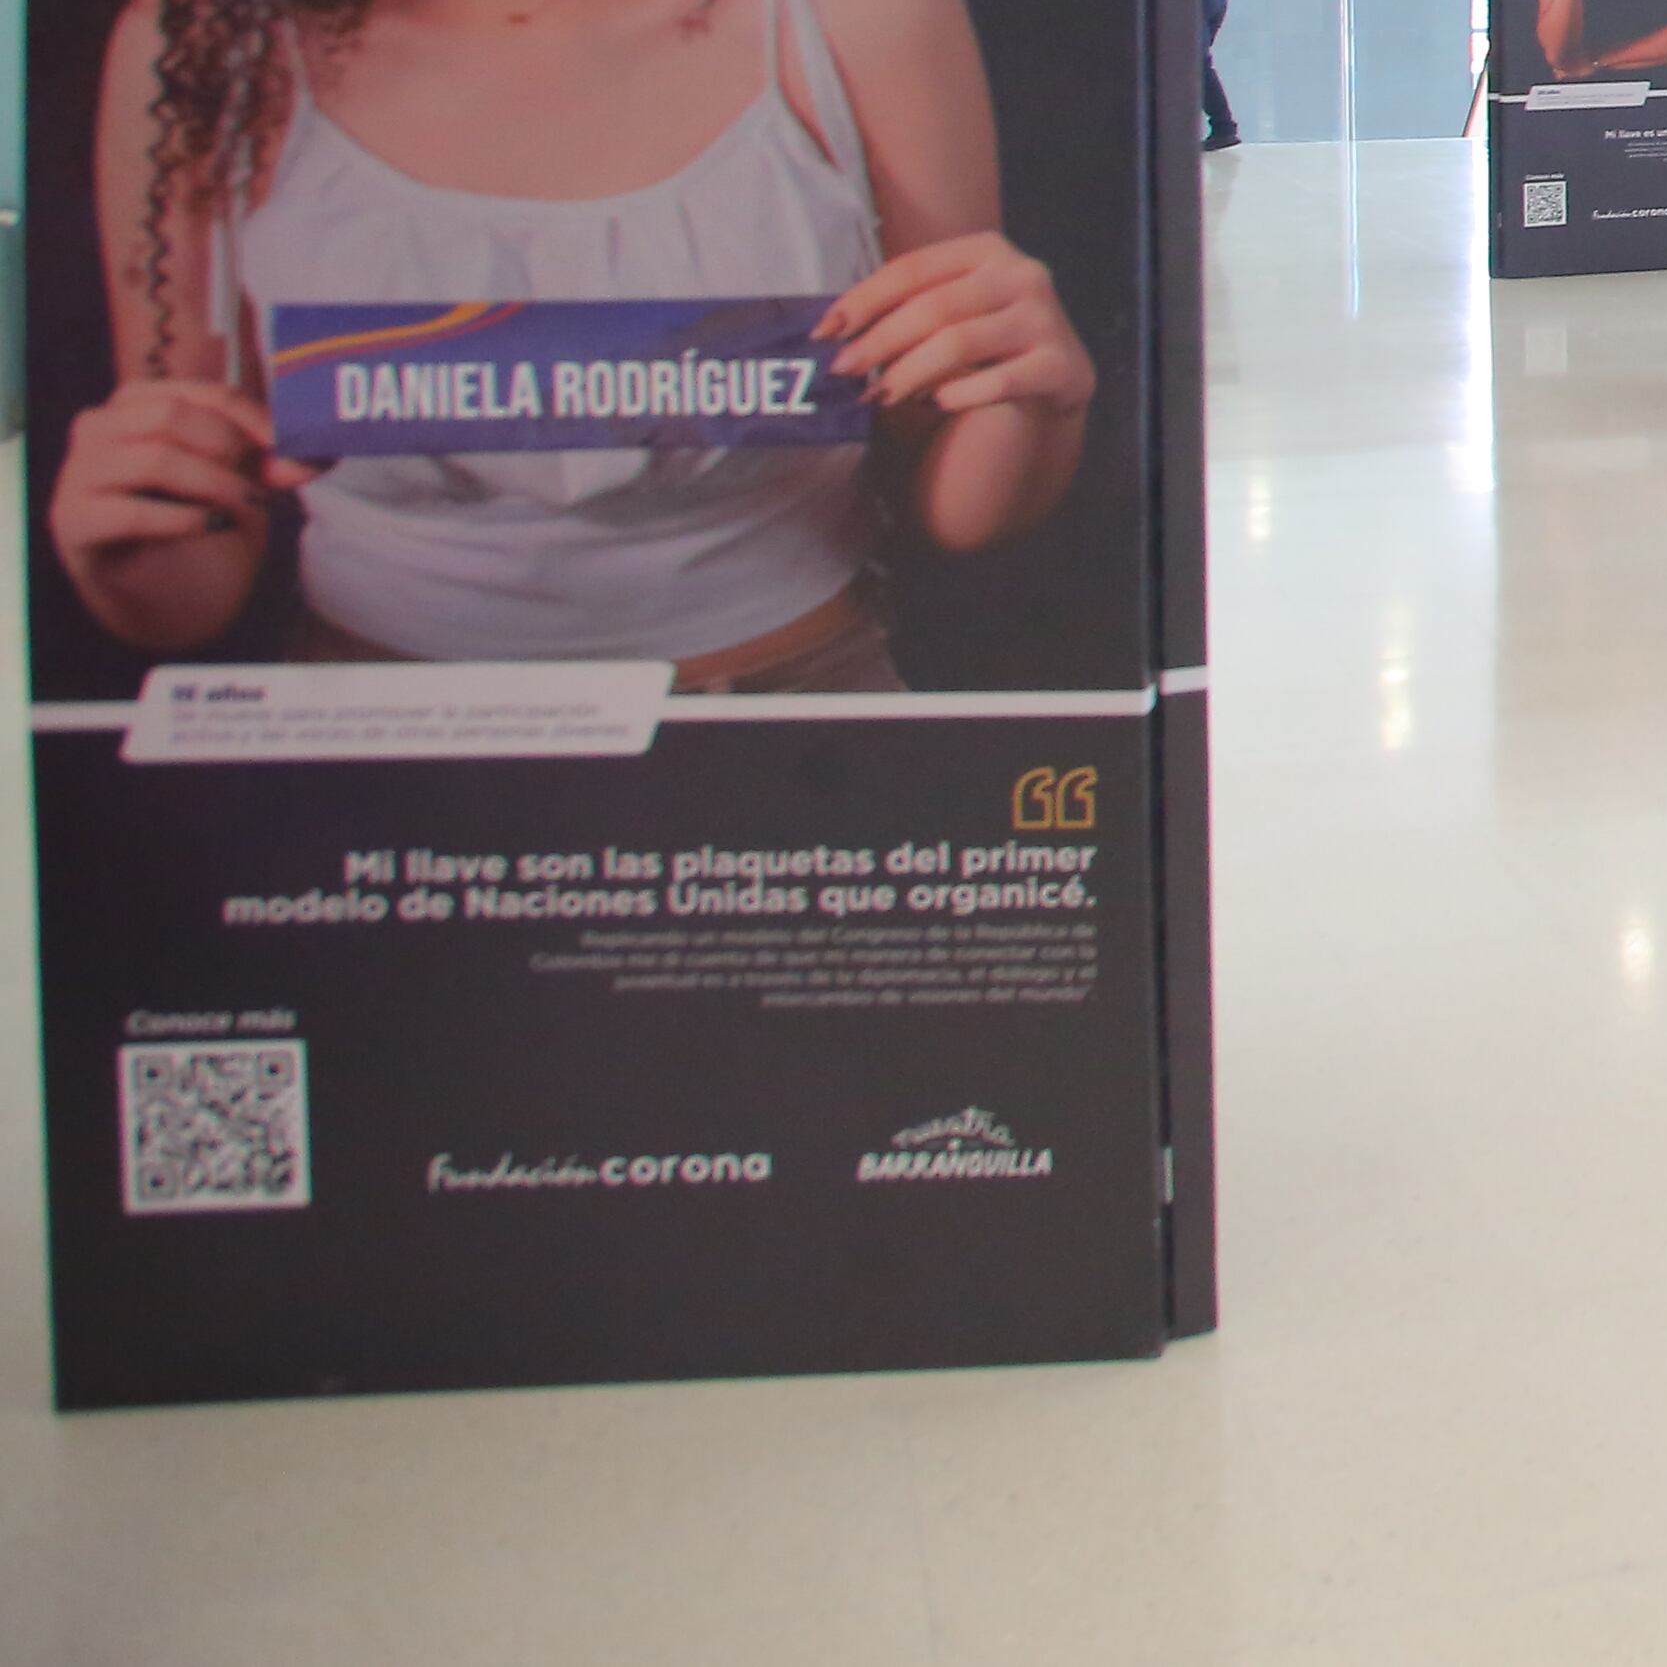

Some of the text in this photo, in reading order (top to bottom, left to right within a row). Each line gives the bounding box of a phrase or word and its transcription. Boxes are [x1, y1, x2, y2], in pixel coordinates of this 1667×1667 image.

[336, 355, 817, 419] DANIELA RODRÍGUEZ
[344, 842, 1097, 889] Mi llave son las plaquetas del primer
[222, 877, 1097, 923] modelo de Naciones Unidas que organicé.
[599, 1147, 773, 1187] corona
[857, 1145, 1052, 1183] BARRANQUILLA
